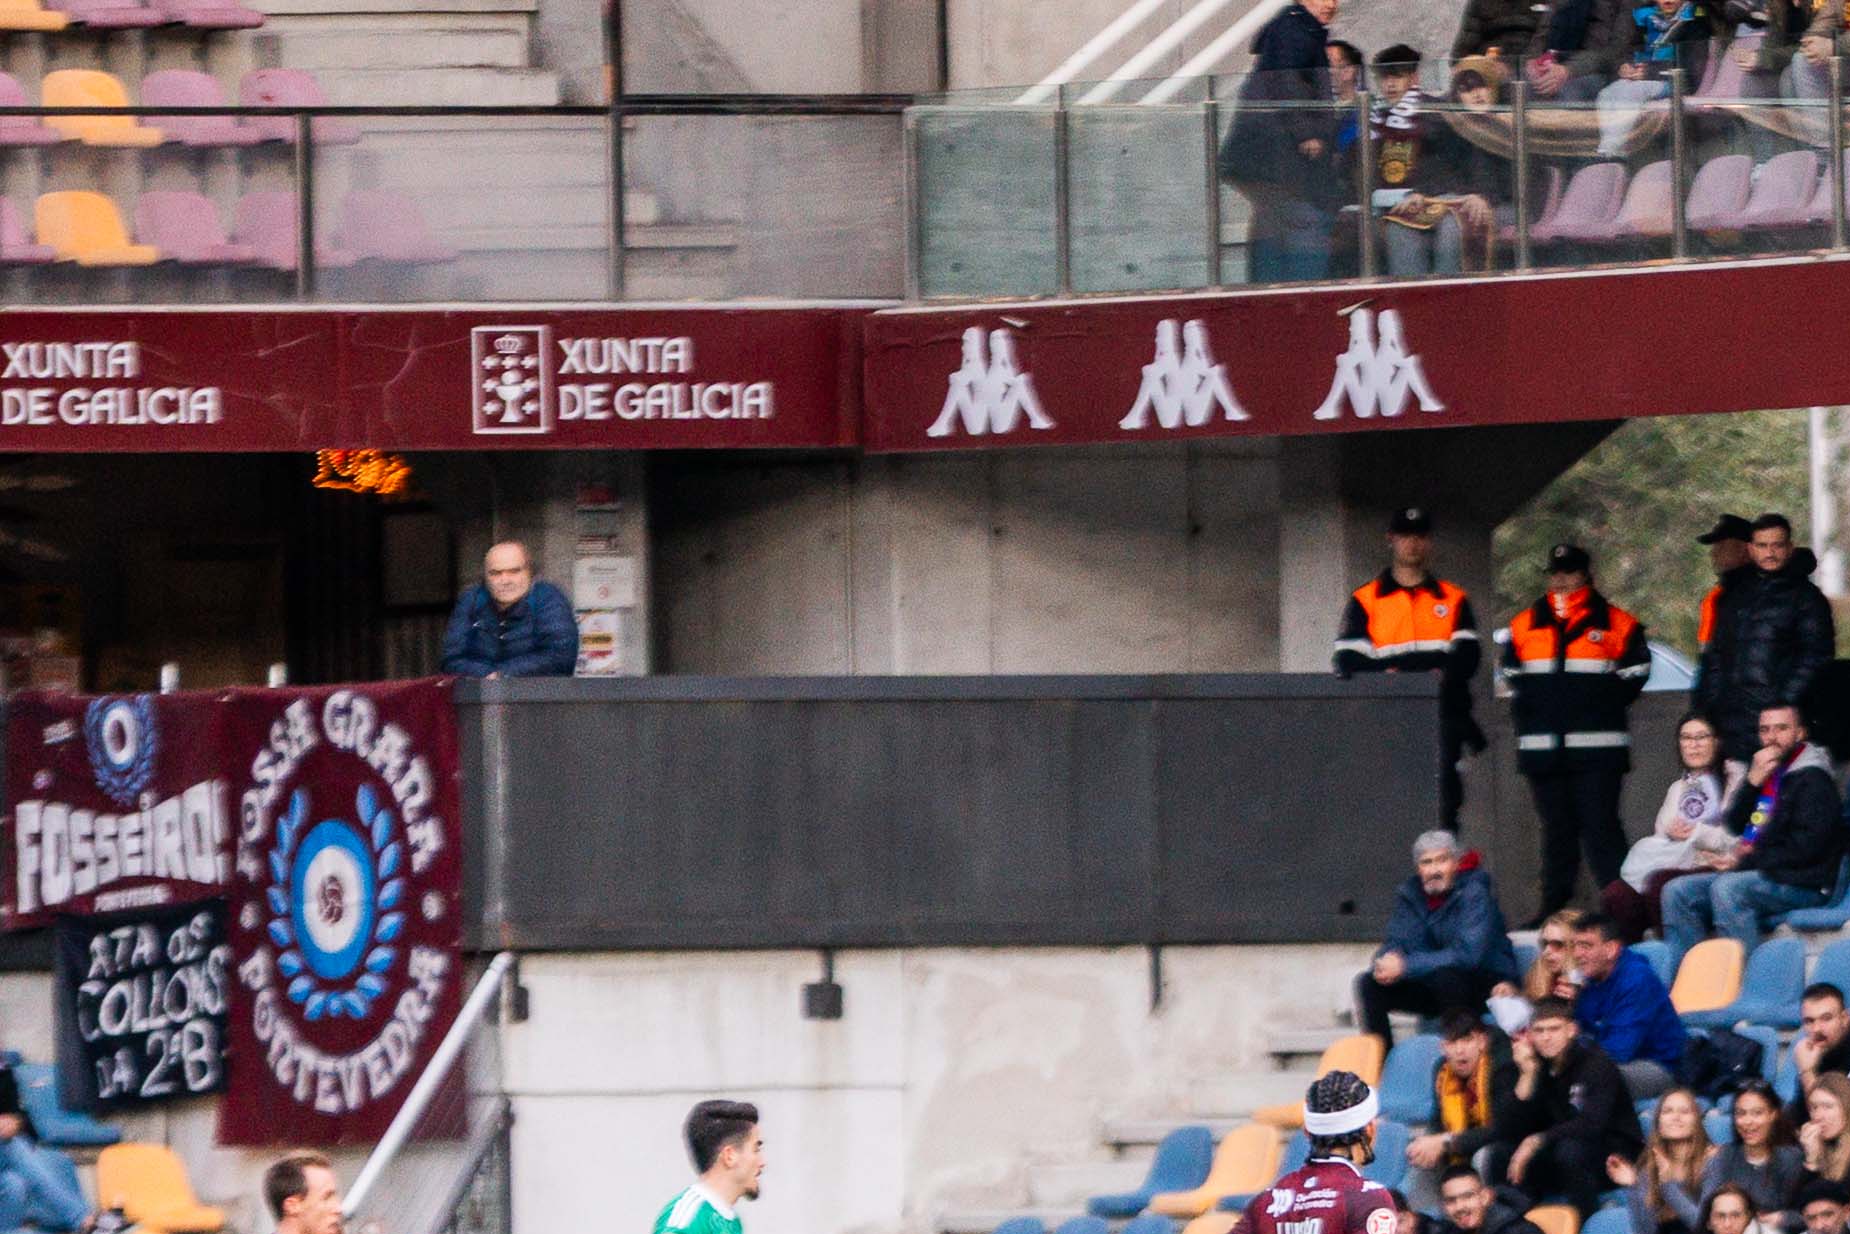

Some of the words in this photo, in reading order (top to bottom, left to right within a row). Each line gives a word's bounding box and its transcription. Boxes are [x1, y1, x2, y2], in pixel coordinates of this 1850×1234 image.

[1, 340, 140, 379] XUNTA
[557, 336, 693, 375] XUNTA
[1, 387, 56, 425] DE
[60, 386, 223, 426] GALICIA
[557, 383, 608, 421] DE
[612, 381, 774, 421] GALICIA
